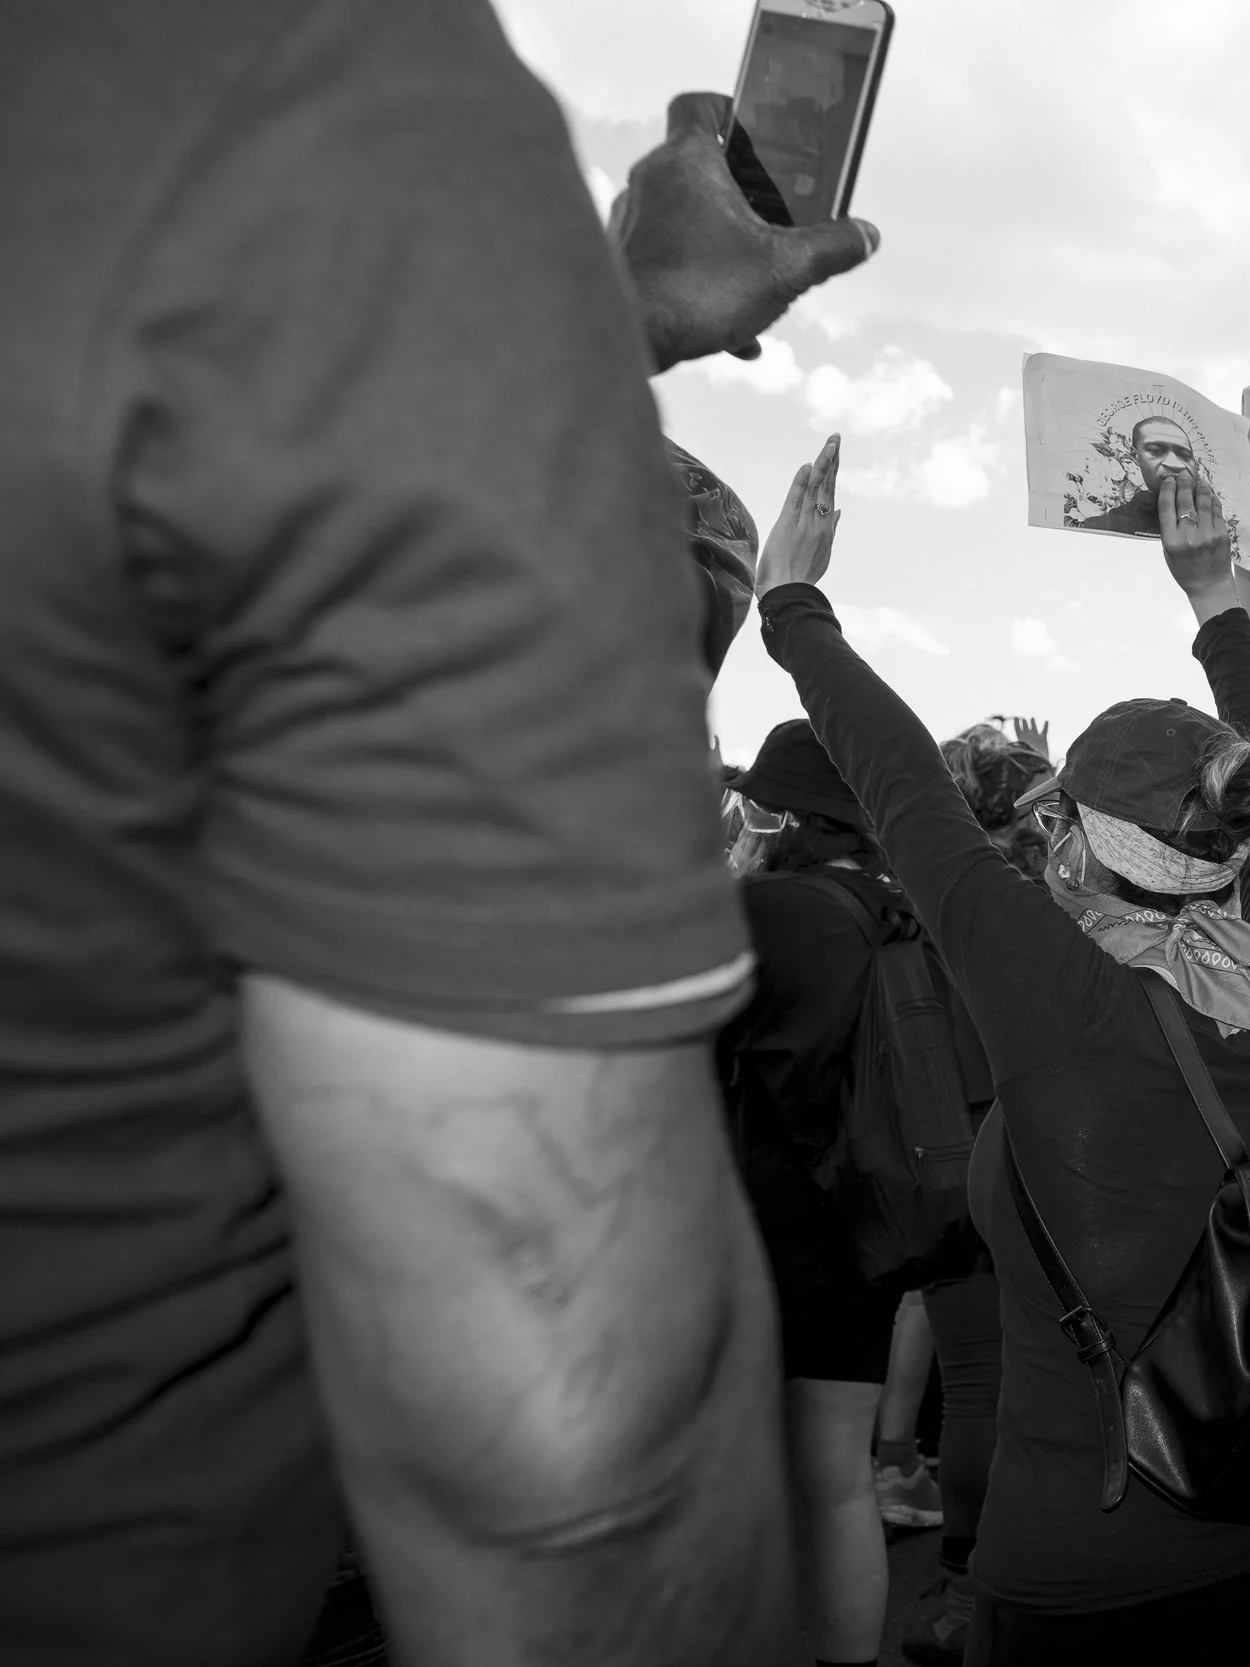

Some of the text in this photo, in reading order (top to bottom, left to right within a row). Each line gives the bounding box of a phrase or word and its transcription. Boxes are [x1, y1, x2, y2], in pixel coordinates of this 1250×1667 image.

[1096, 396, 1132, 427] GEORGE
[1133, 393, 1171, 406] FLOYD
[1172, 400, 1184, 413] IS
